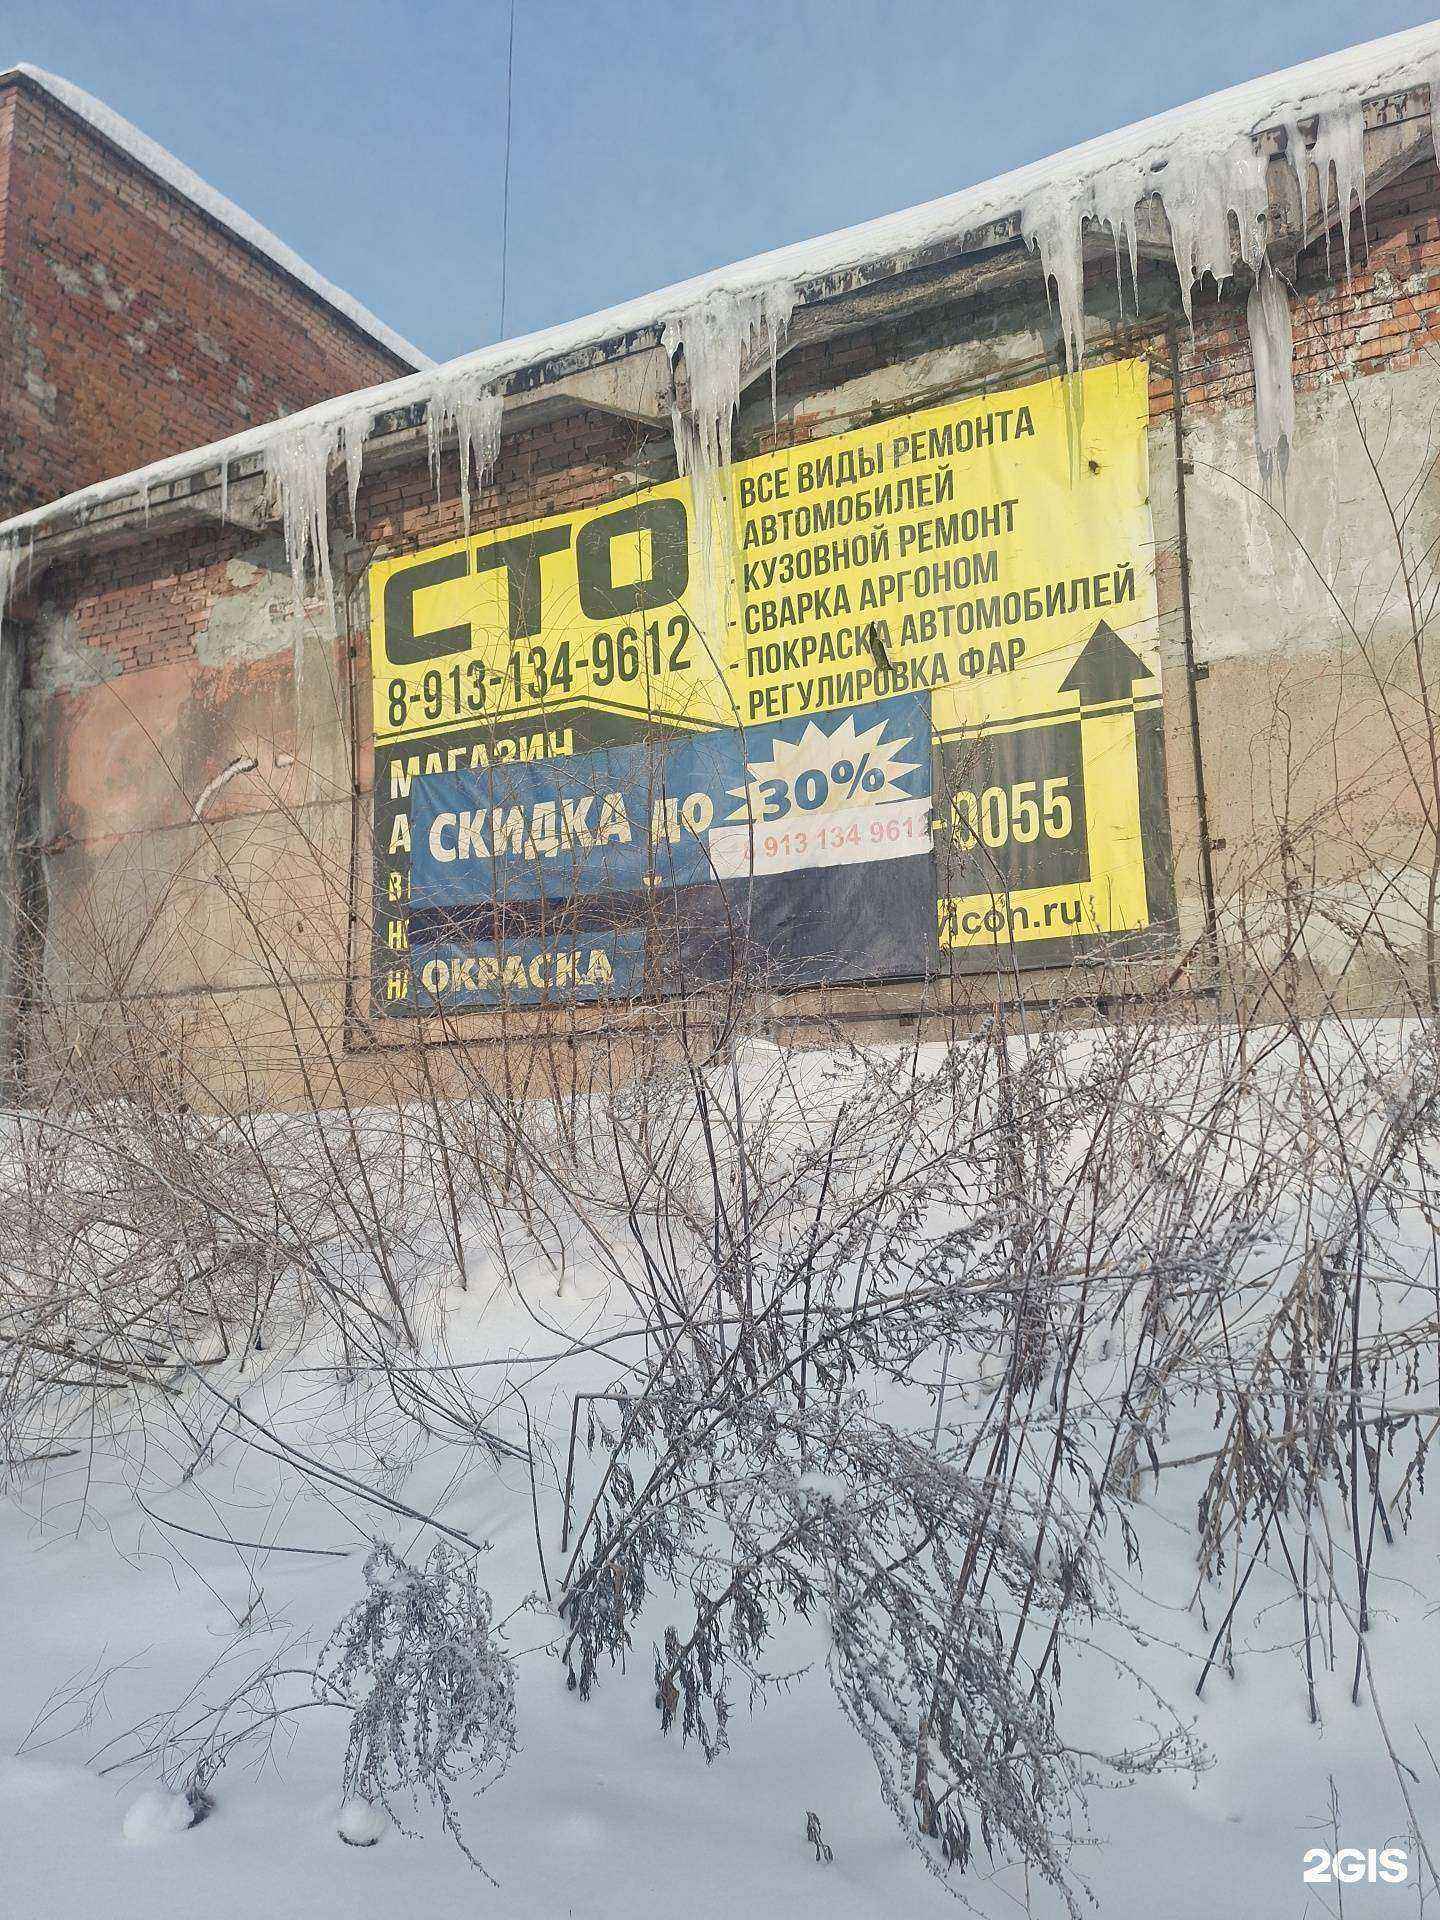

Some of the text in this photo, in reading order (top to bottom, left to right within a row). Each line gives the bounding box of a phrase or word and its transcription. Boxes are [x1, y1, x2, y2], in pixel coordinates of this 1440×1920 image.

[739, 405, 1035, 509] ВСЕ ВИДЫ РЕМОНТА
[742, 463, 955, 550] АВТОМОБИЛЕЙ
[743, 498, 1019, 593] КУЗОВНОЙ РЕМОНТ
[384, 497, 690, 666] СТО
[743, 549, 999, 636] СВАРКА АРГОНОМ
[746, 561, 1137, 678] ПОКРАСКА АВТОМОБИЛЕЙ
[387, 614, 692, 728] 8-913-134-9612
[748, 636, 1027, 720] РЕГУЛИРОВКА ФАР
[428, 751, 887, 864] СКИДКА ДО 30%
[764, 831, 808, 858] 913
[816, 823, 862, 850] 134
[420, 949, 614, 994] ОКРАСКА
